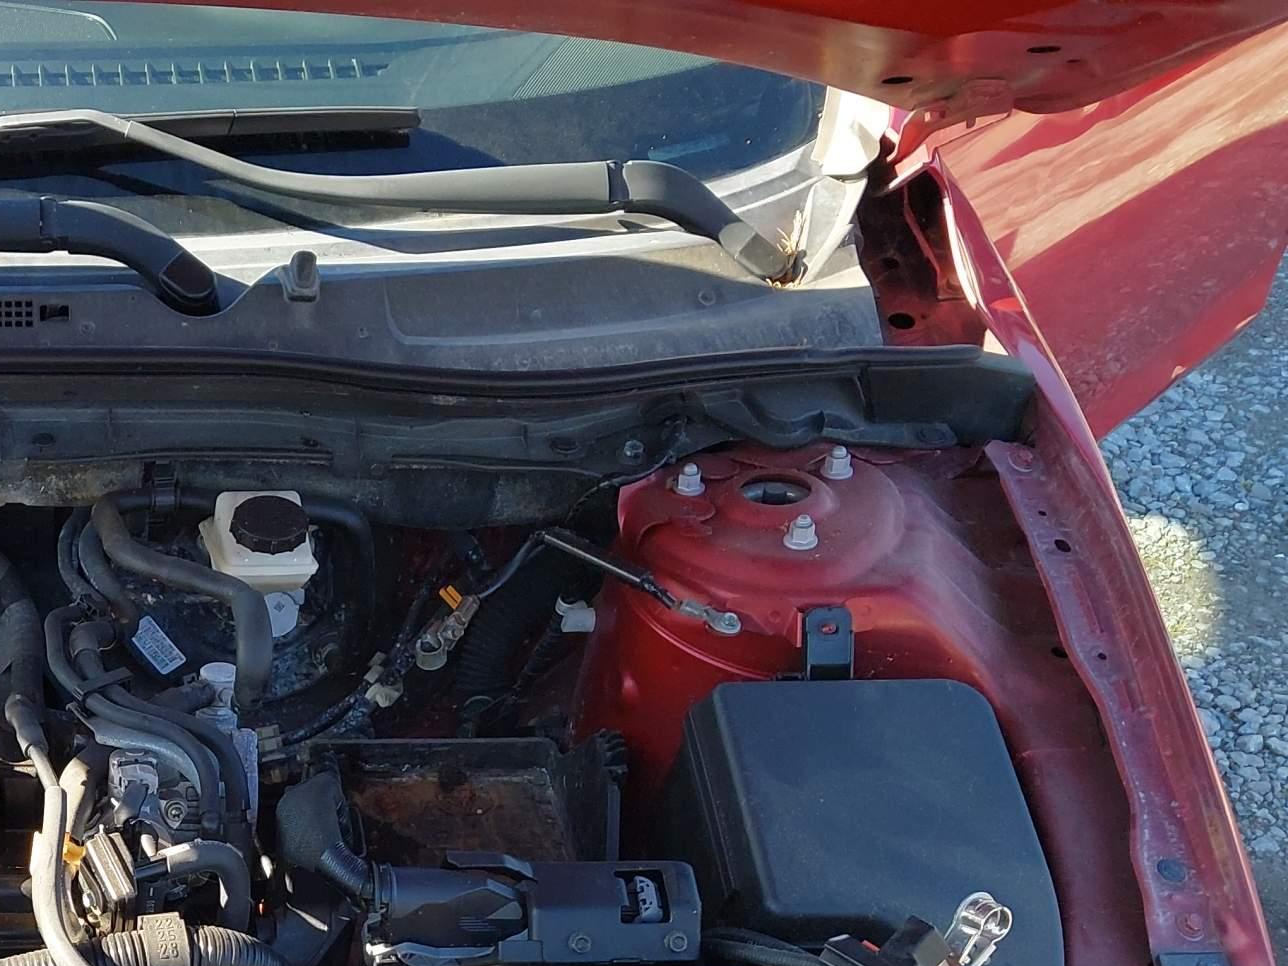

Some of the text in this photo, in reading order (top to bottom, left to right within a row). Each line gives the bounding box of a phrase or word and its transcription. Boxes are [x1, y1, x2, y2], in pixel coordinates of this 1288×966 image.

[155, 917, 175, 930] 22
[157, 929, 177, 942] 25
[159, 941, 180, 960] 28
